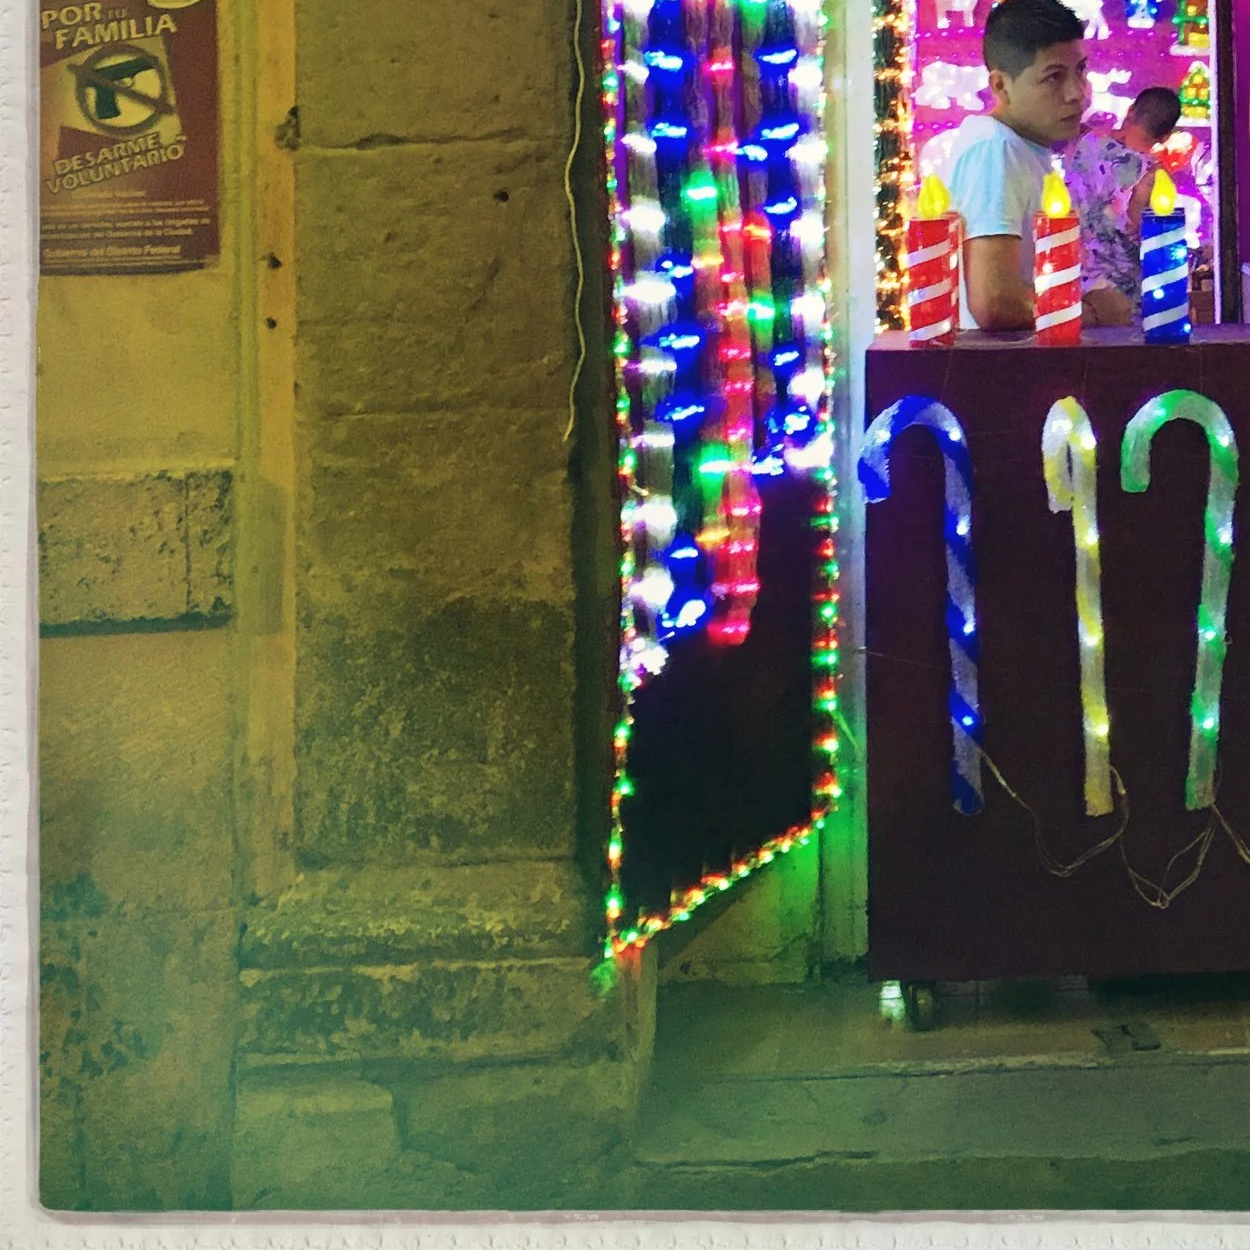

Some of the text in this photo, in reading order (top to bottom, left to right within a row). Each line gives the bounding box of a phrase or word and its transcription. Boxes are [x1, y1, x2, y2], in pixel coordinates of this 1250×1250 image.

[41, 2, 102, 29] POR
[55, 13, 177, 50] FAMILIA
[46, 144, 185, 194] VOLUNTARIO
[53, 133, 160, 175] DESARME
